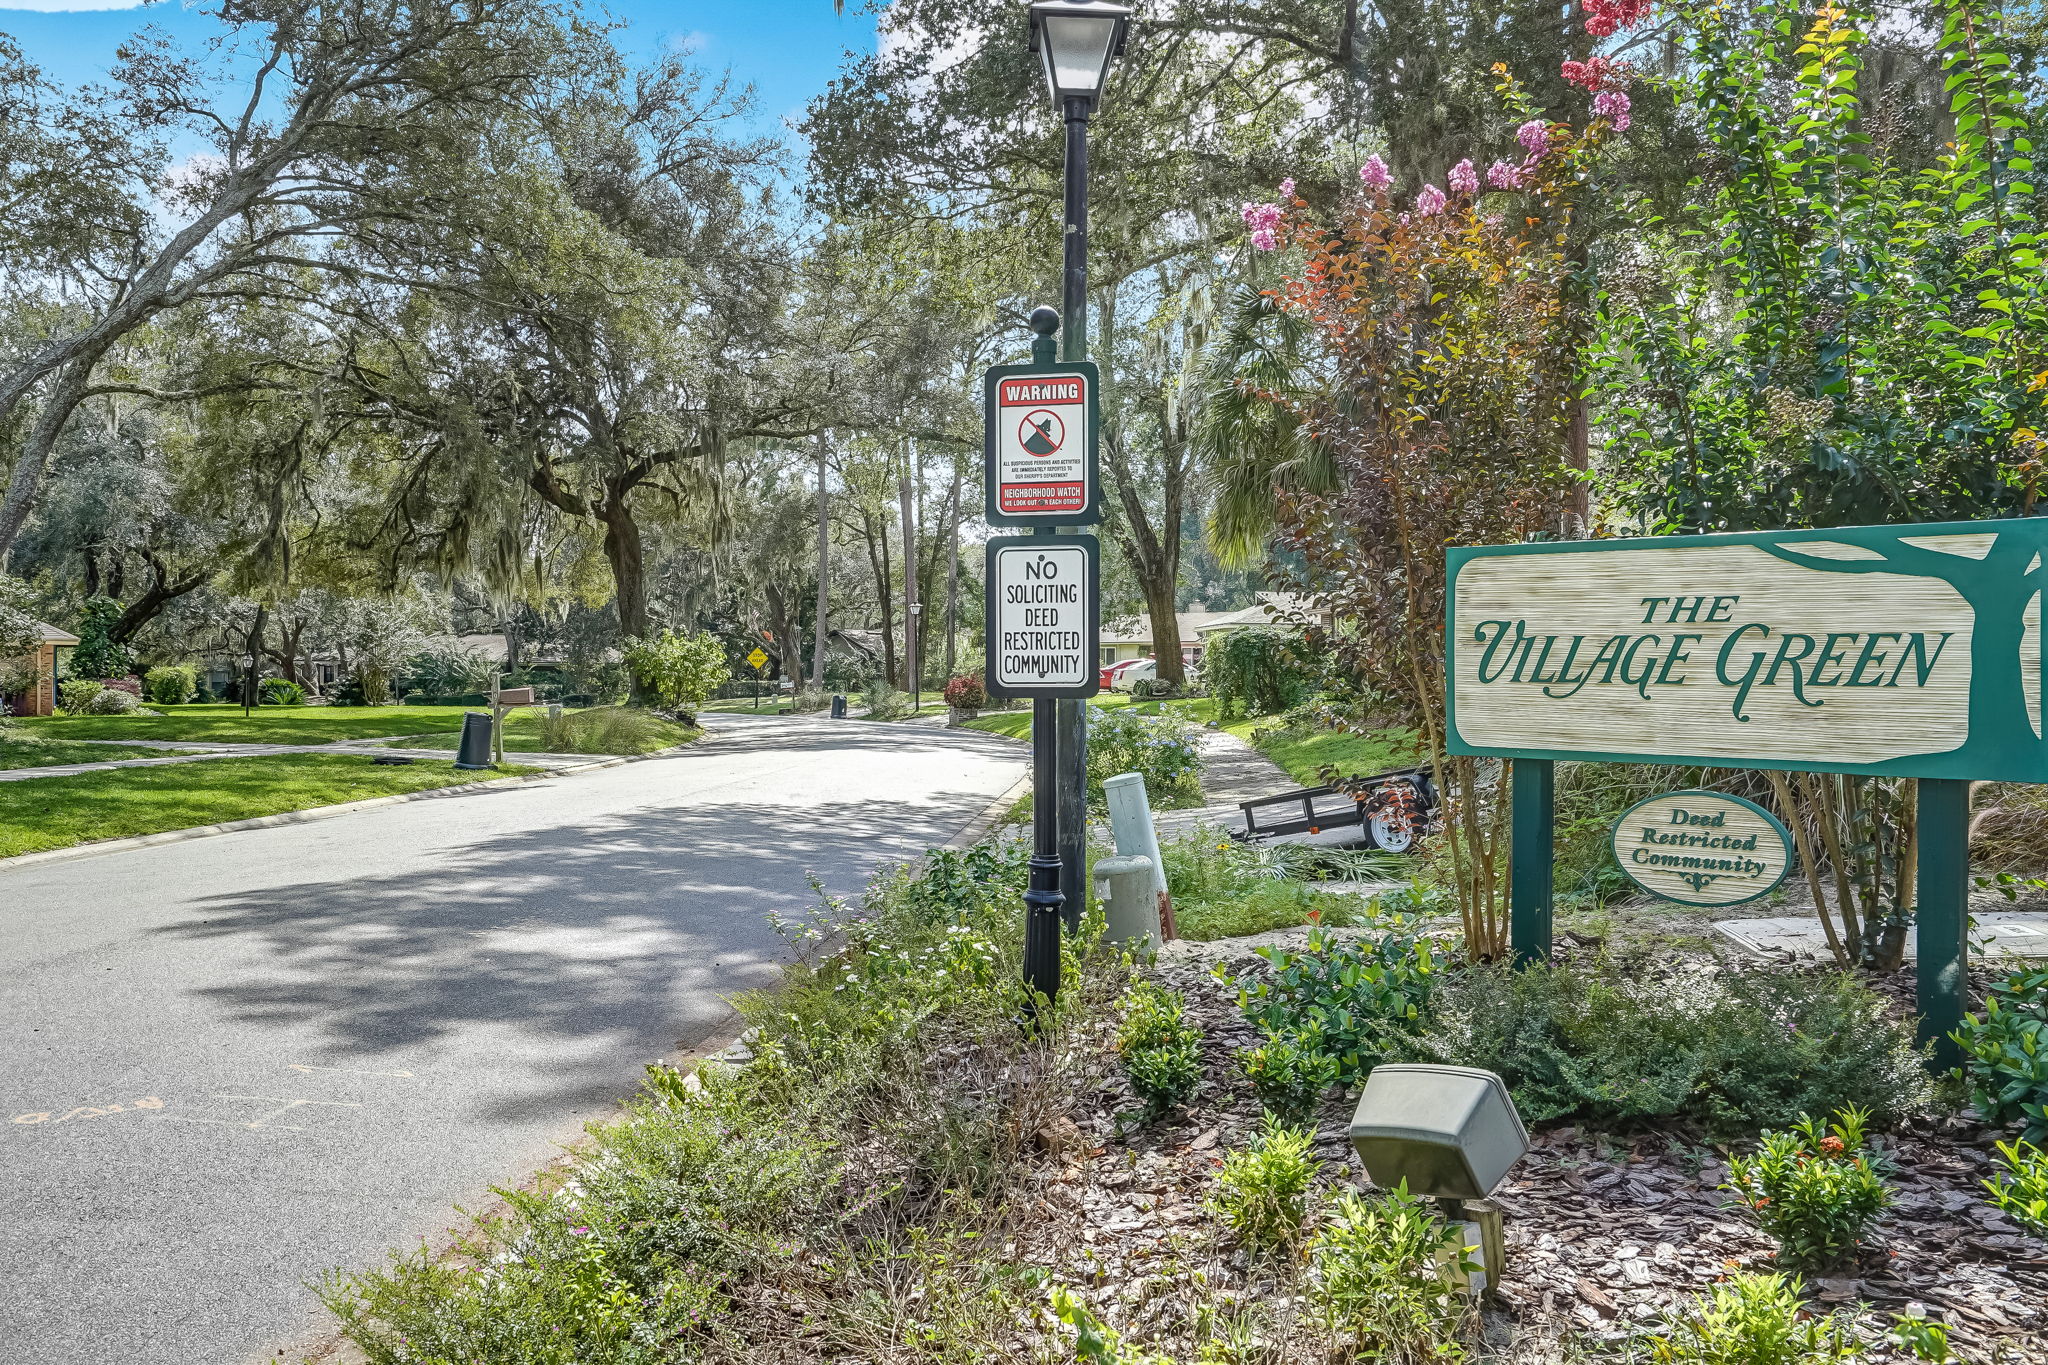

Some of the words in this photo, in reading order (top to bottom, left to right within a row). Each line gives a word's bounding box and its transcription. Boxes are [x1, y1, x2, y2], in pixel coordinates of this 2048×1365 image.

[1006, 383, 1079, 402] WARNING
[1004, 487, 1056, 499] NEIGHBORHOOD
[1057, 486, 1081, 497] WATCH
[1049, 498, 1062, 506] EACH
[1026, 561, 1057, 580] NO
[1007, 584, 1077, 604] SOLICITING
[1025, 608, 1059, 627] DEED
[1640, 595, 1741, 624] THE
[1004, 631, 1080, 651] RESTRICTED
[1004, 655, 1080, 674] COMMUNITY
[1714, 622, 1955, 723] GREEN
[1669, 808, 1726, 828] Deed
[1641, 827, 1758, 851] Restricted
[1632, 847, 1767, 878] Community
